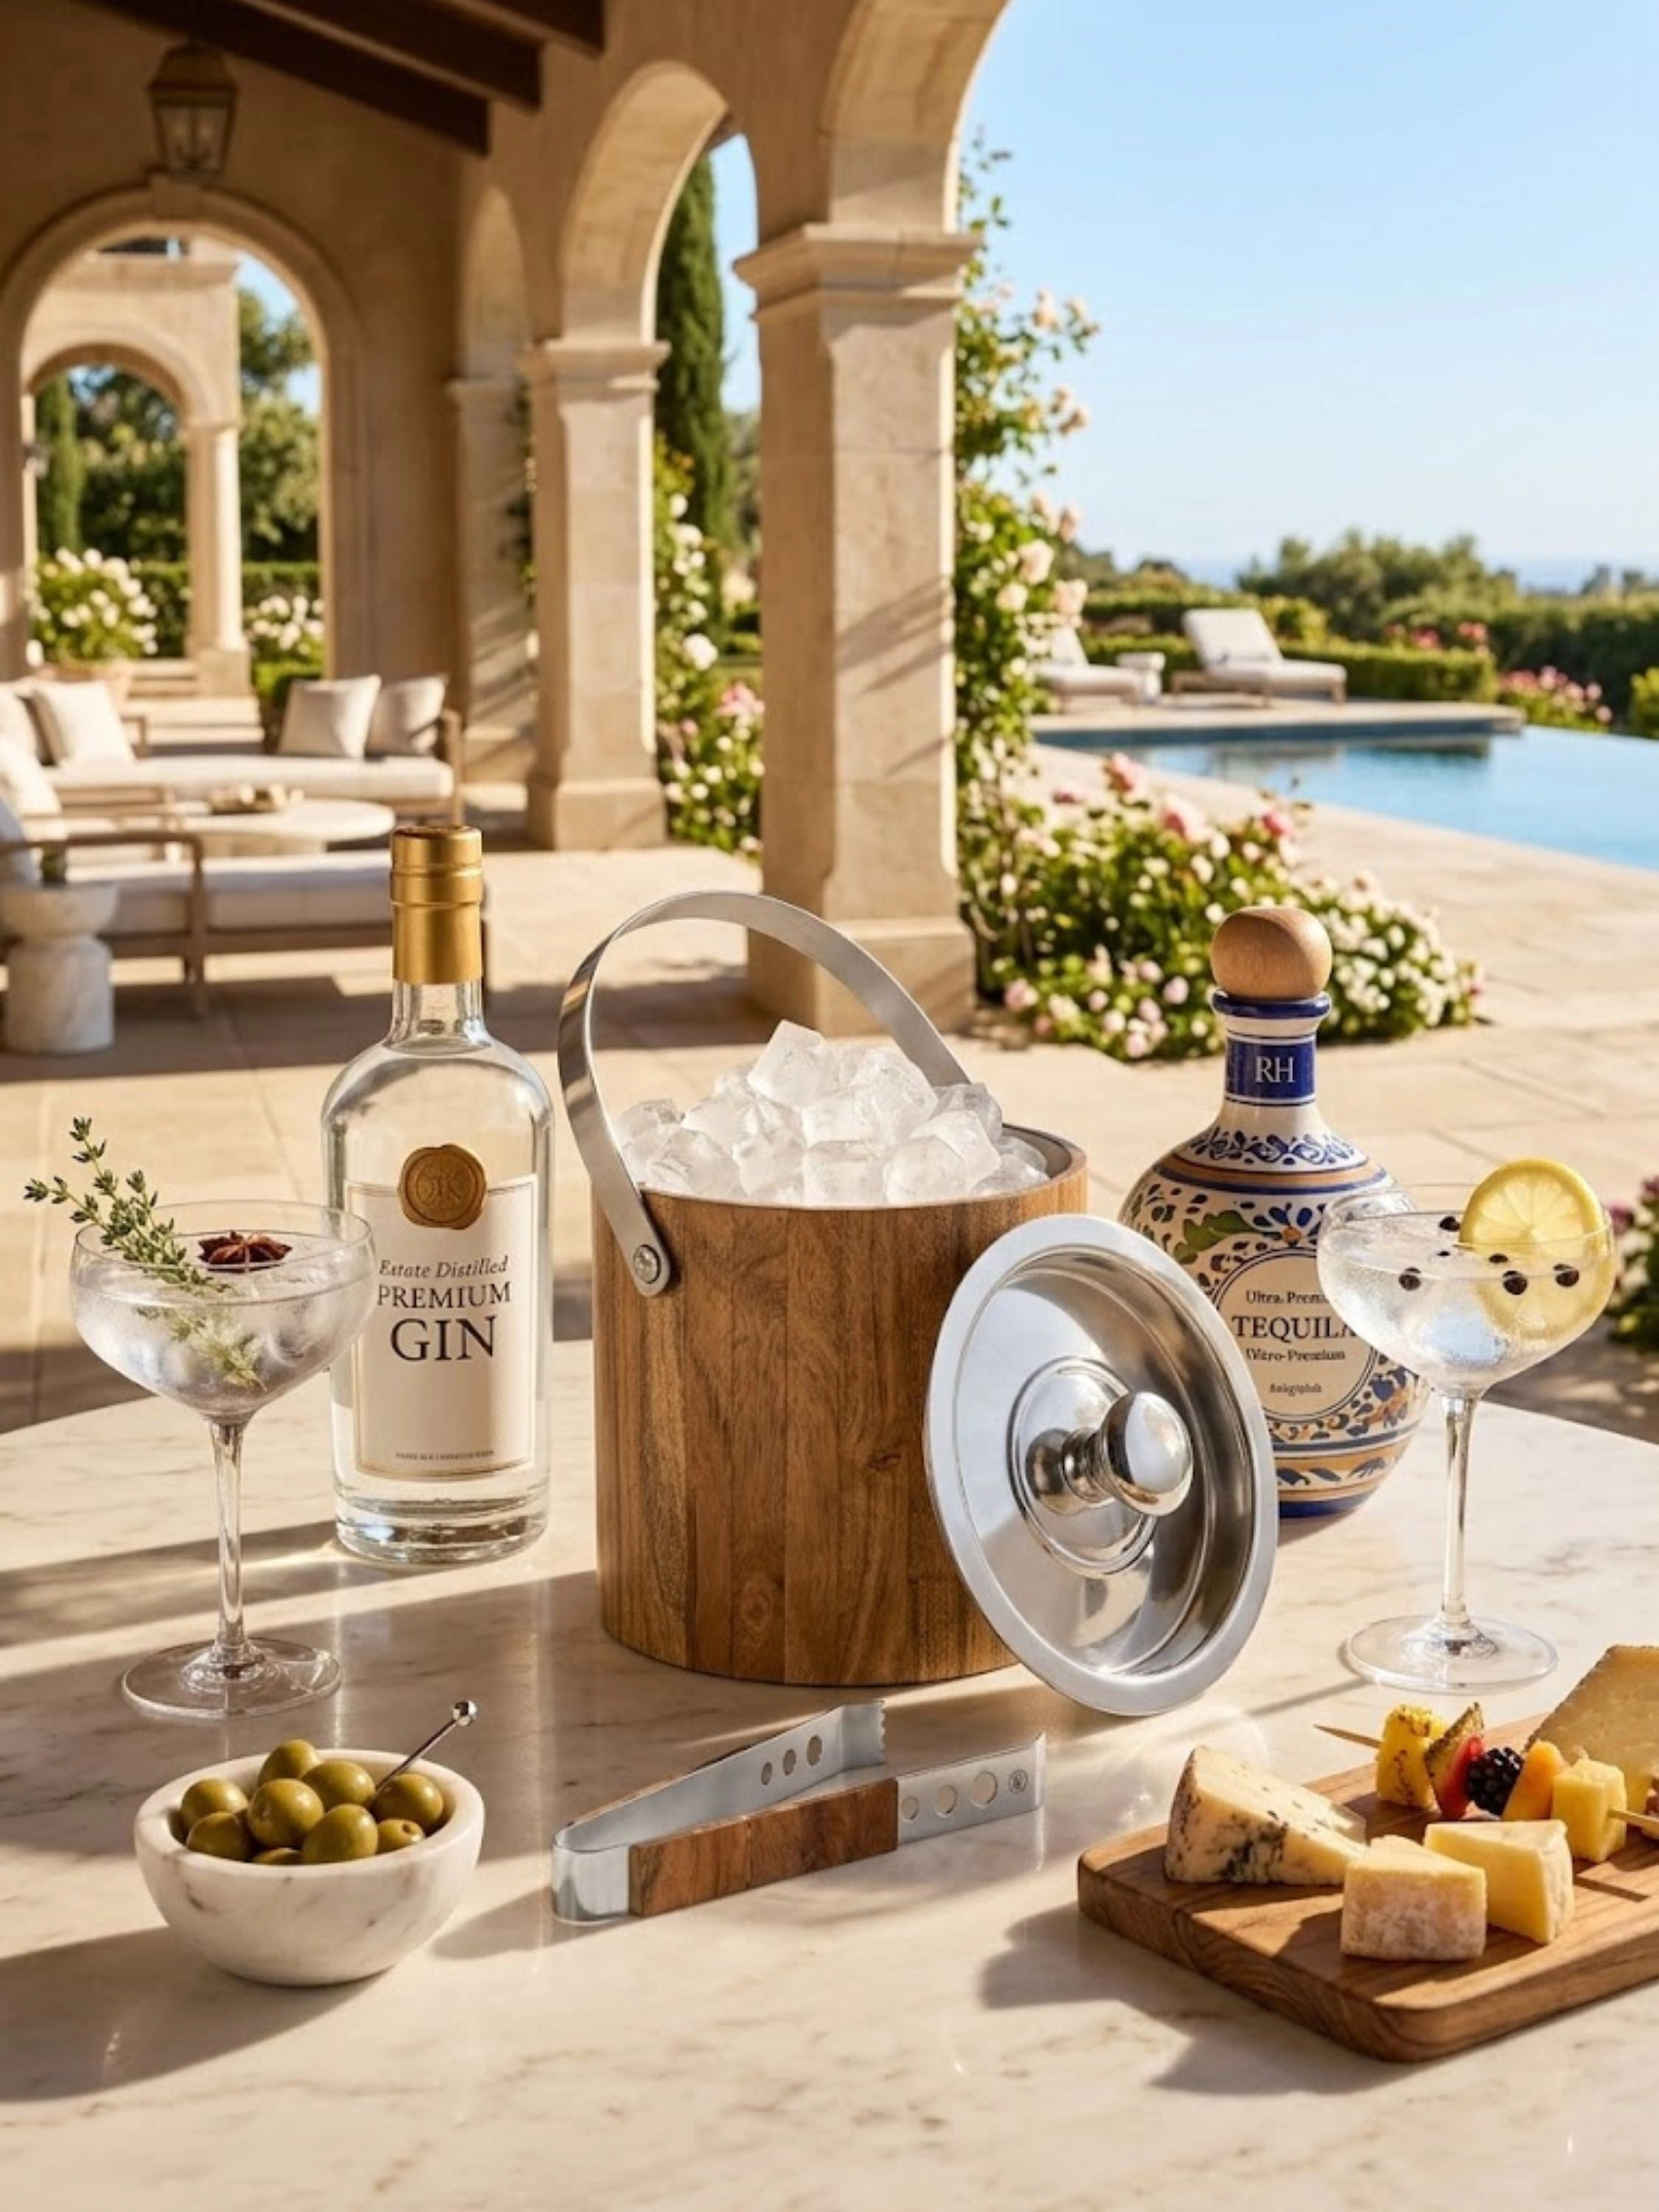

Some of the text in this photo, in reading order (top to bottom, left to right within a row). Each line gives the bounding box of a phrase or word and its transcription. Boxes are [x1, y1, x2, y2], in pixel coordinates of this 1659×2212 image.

[1255, 1056, 1296, 1083] RH
[435, 1255, 509, 1279] Distilled
[378, 1281, 511, 1309] PREMIUM
[390, 1315, 497, 1360] GIN
